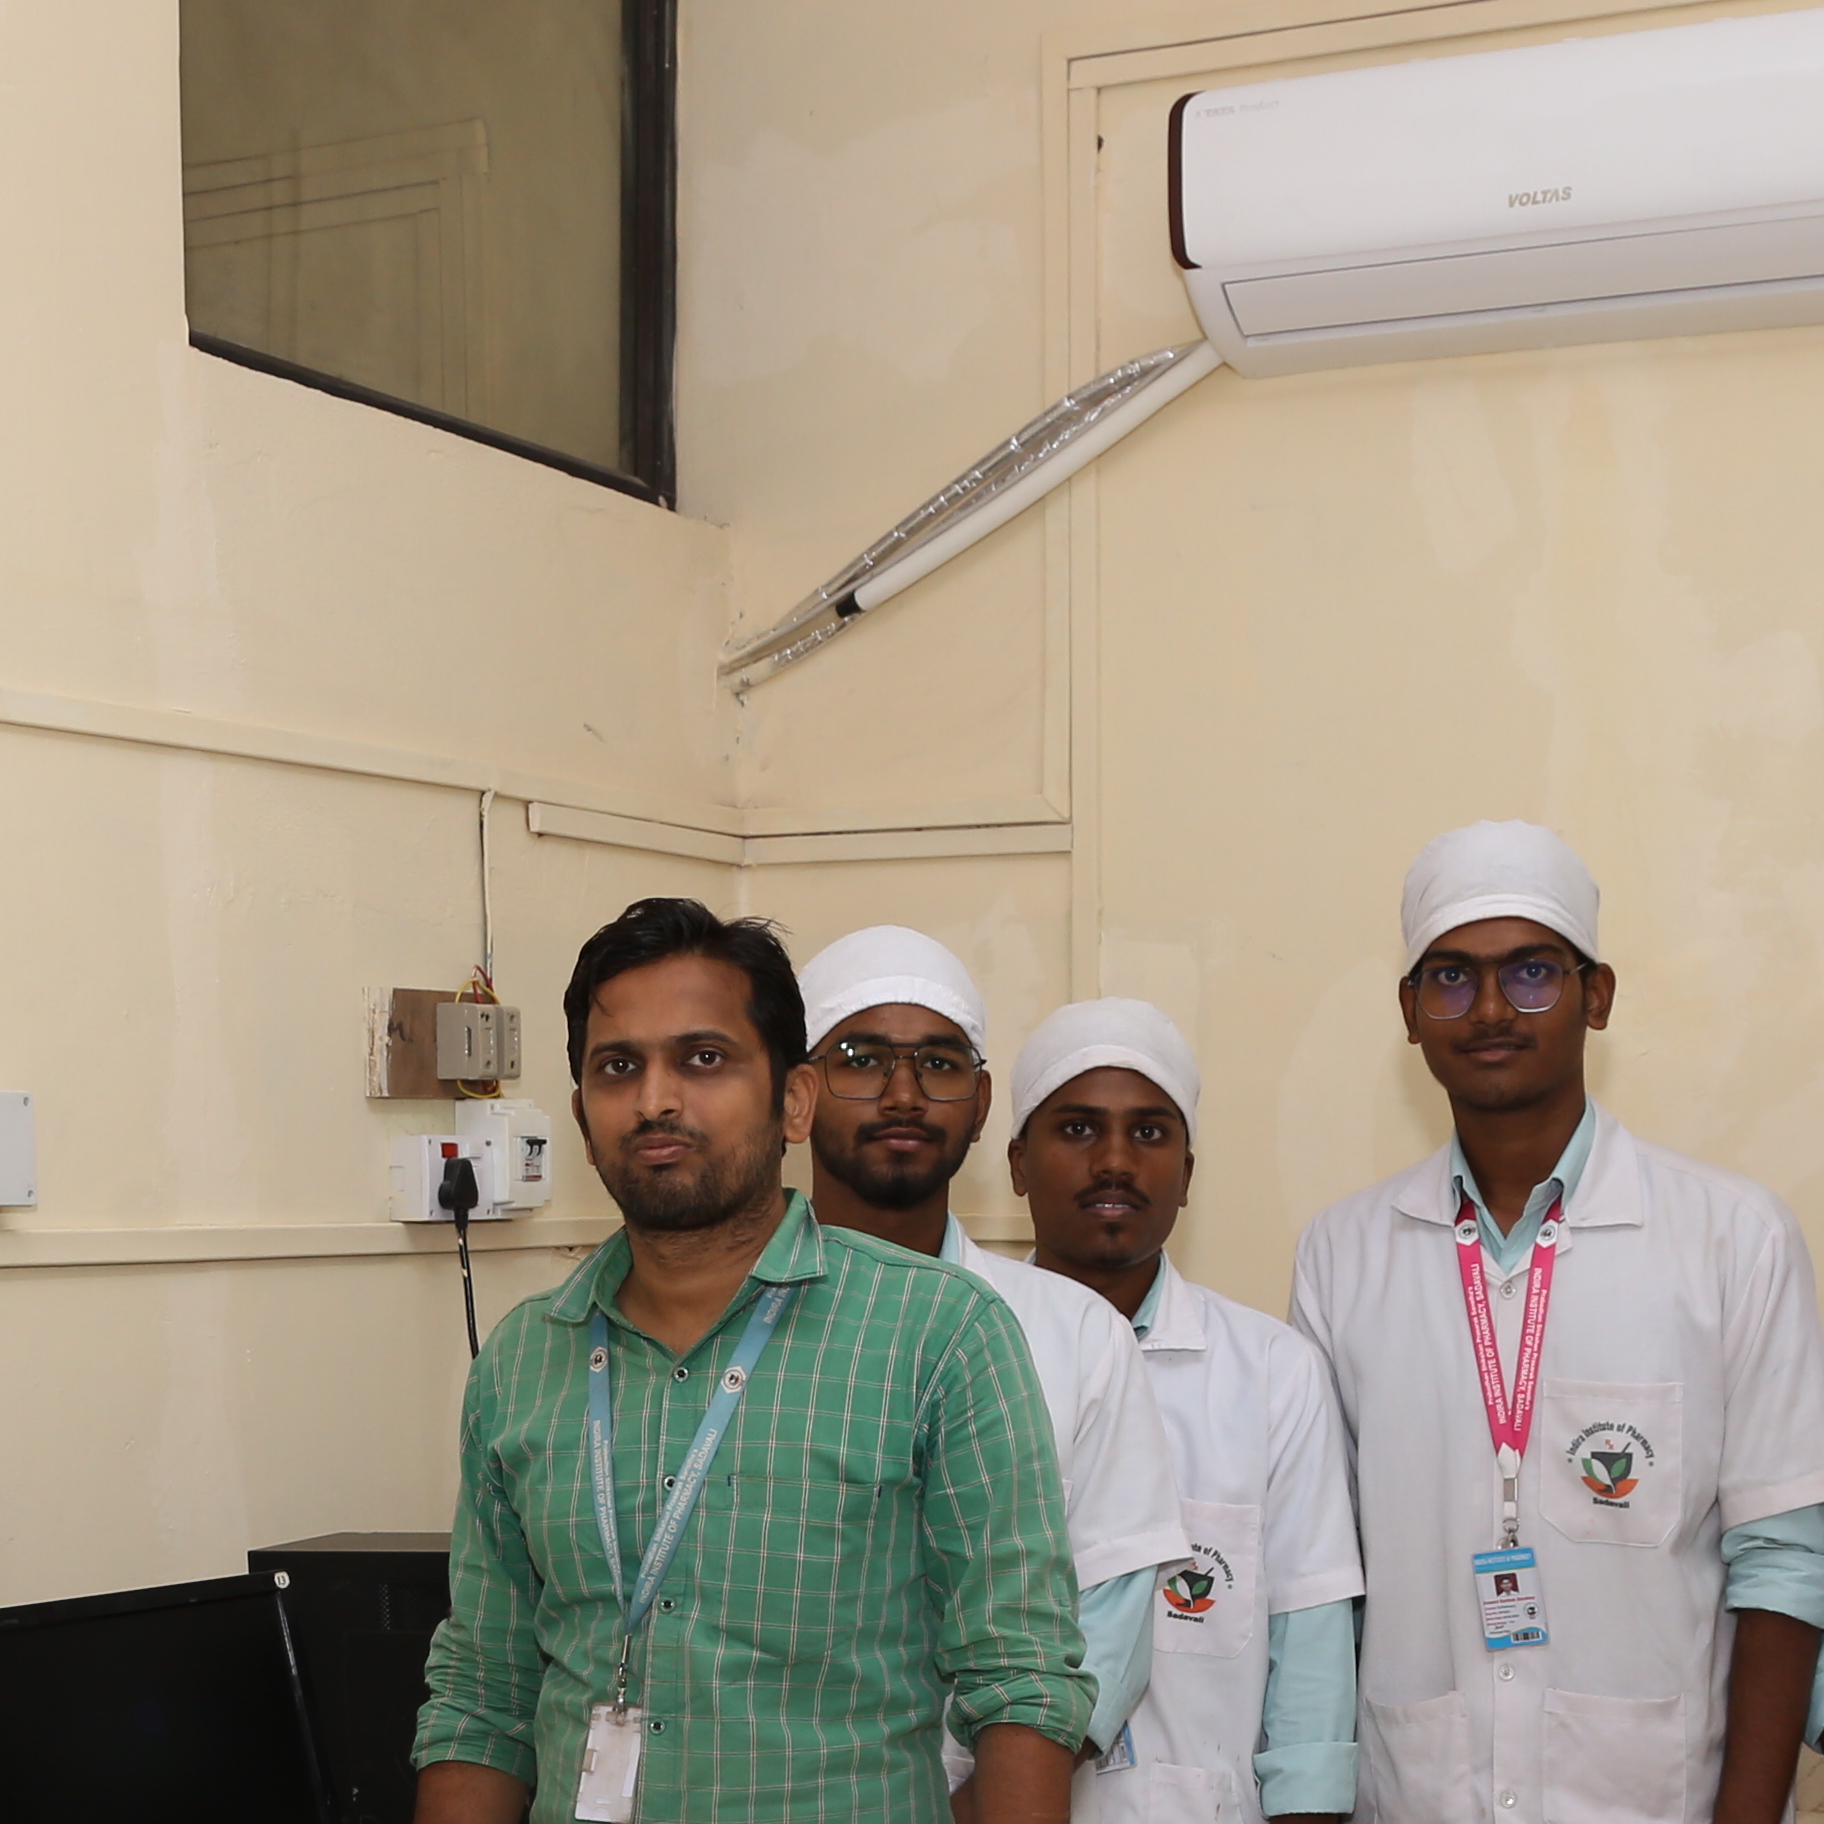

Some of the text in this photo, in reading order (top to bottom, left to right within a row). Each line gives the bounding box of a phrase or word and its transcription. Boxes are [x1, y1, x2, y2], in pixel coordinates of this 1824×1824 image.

[1508, 186, 1572, 208] VOLTAS
[1471, 1263, 1507, 1423] INDIRA INSTITUTE OF PHARMACY, SADAVALI
[1513, 1267, 1542, 1431] INDIRA INSTITUTE OF PHARMACY, SADAVALI
[1566, 1421, 1654, 1459] Indira Institute of Pharmacy
[594, 1448, 603, 1491] INSTITUTE
[597, 1493, 605, 1505] OF
[638, 1427, 716, 1603] INDIRA INSTITUTE OF PHARMACY, SADAVALI
[1593, 1497, 1630, 1508] Sadavali
[639, 1542, 657, 1578] Prabodhan
[654, 1511, 670, 1541] Shikshan
[667, 1481, 683, 1509] Prasarak
[1203, 1547, 1212, 1556] of
[1211, 1550, 1234, 1582] Pharmacy
[1167, 1611, 1204, 1623] Sadavali
